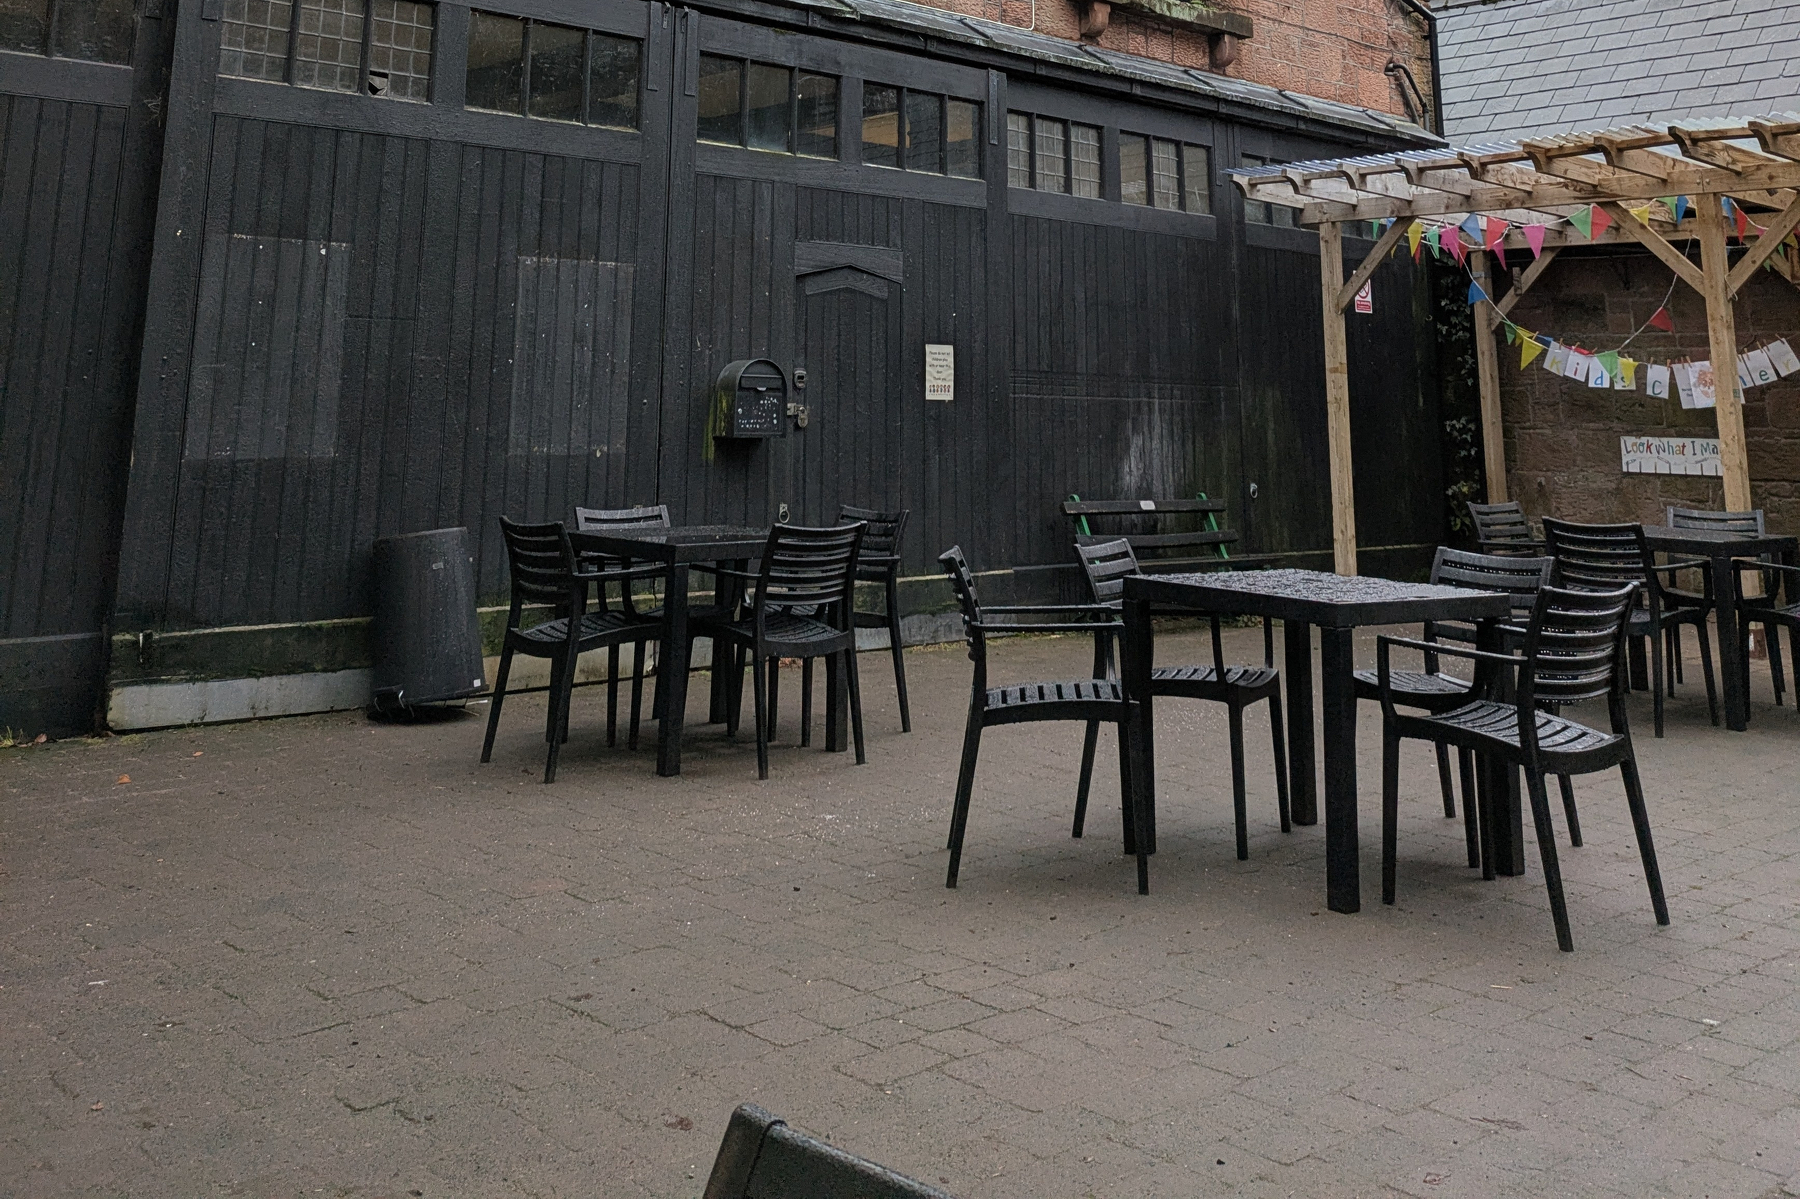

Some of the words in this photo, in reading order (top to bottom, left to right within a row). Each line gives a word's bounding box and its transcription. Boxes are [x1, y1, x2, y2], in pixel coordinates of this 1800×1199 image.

[1623, 439, 1653, 454] Look
[1690, 440, 1697, 456] I
[1700, 442, 1719, 456] Ma
